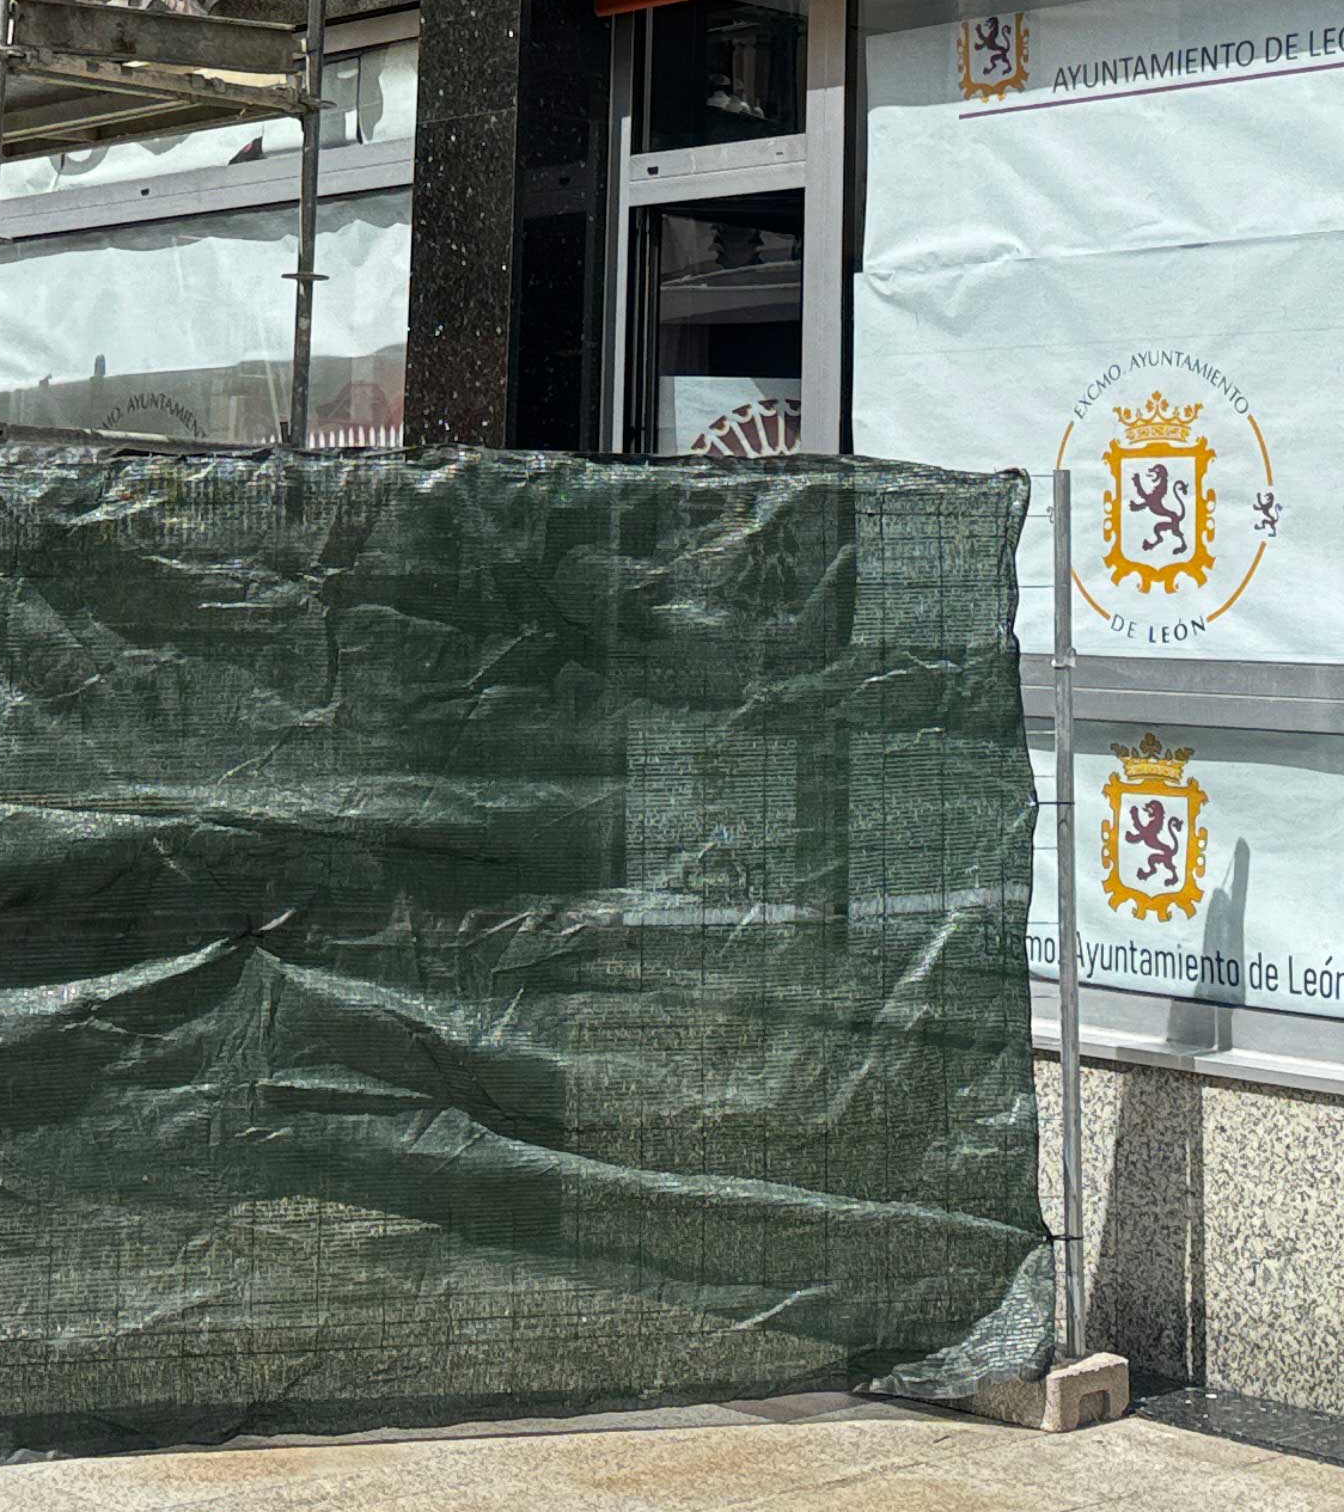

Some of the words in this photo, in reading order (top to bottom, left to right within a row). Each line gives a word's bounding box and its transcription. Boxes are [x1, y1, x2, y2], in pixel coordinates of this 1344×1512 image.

[1052, 39, 1256, 93] AYUNTAMIENTO
[1264, 32, 1300, 64] DE
[1129, 350, 1250, 415] AYUNTAMIENTO
[1110, 614, 1137, 639] DE
[1148, 615, 1206, 644] LEÓN
[1248, 952, 1280, 993] de
